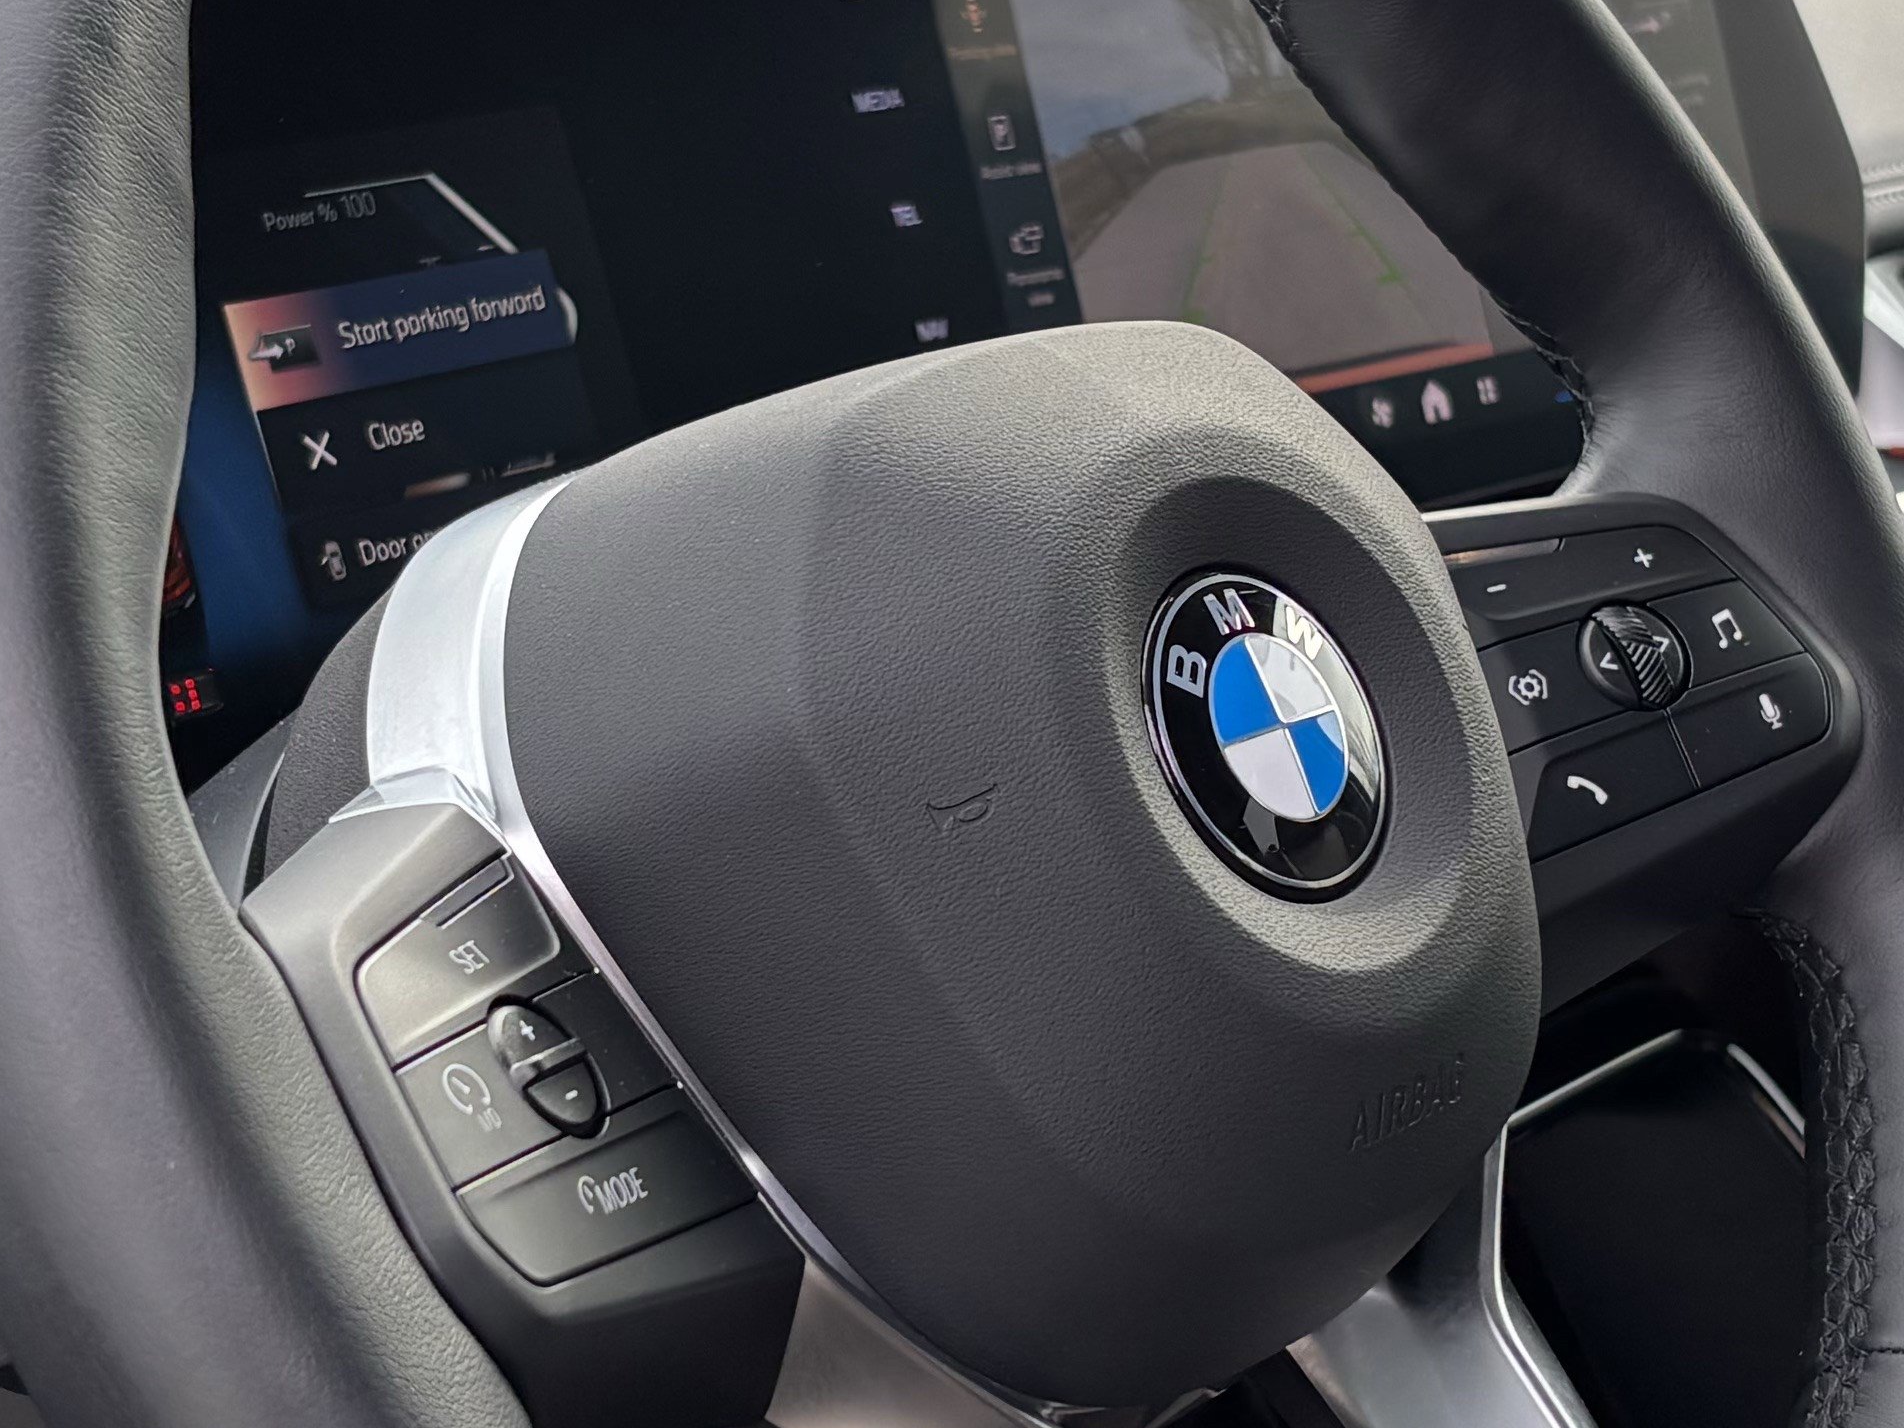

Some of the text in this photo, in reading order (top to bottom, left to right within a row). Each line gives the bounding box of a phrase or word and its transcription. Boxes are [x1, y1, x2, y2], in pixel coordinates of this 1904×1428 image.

[263, 190, 377, 232] Power % 100
[337, 283, 548, 350] Start parking forward
[367, 419, 427, 451] Close
[358, 536, 408, 567] Door
[1166, 587, 1324, 699] BMW
[448, 939, 491, 974] SET
[593, 1166, 649, 1215] MODE
